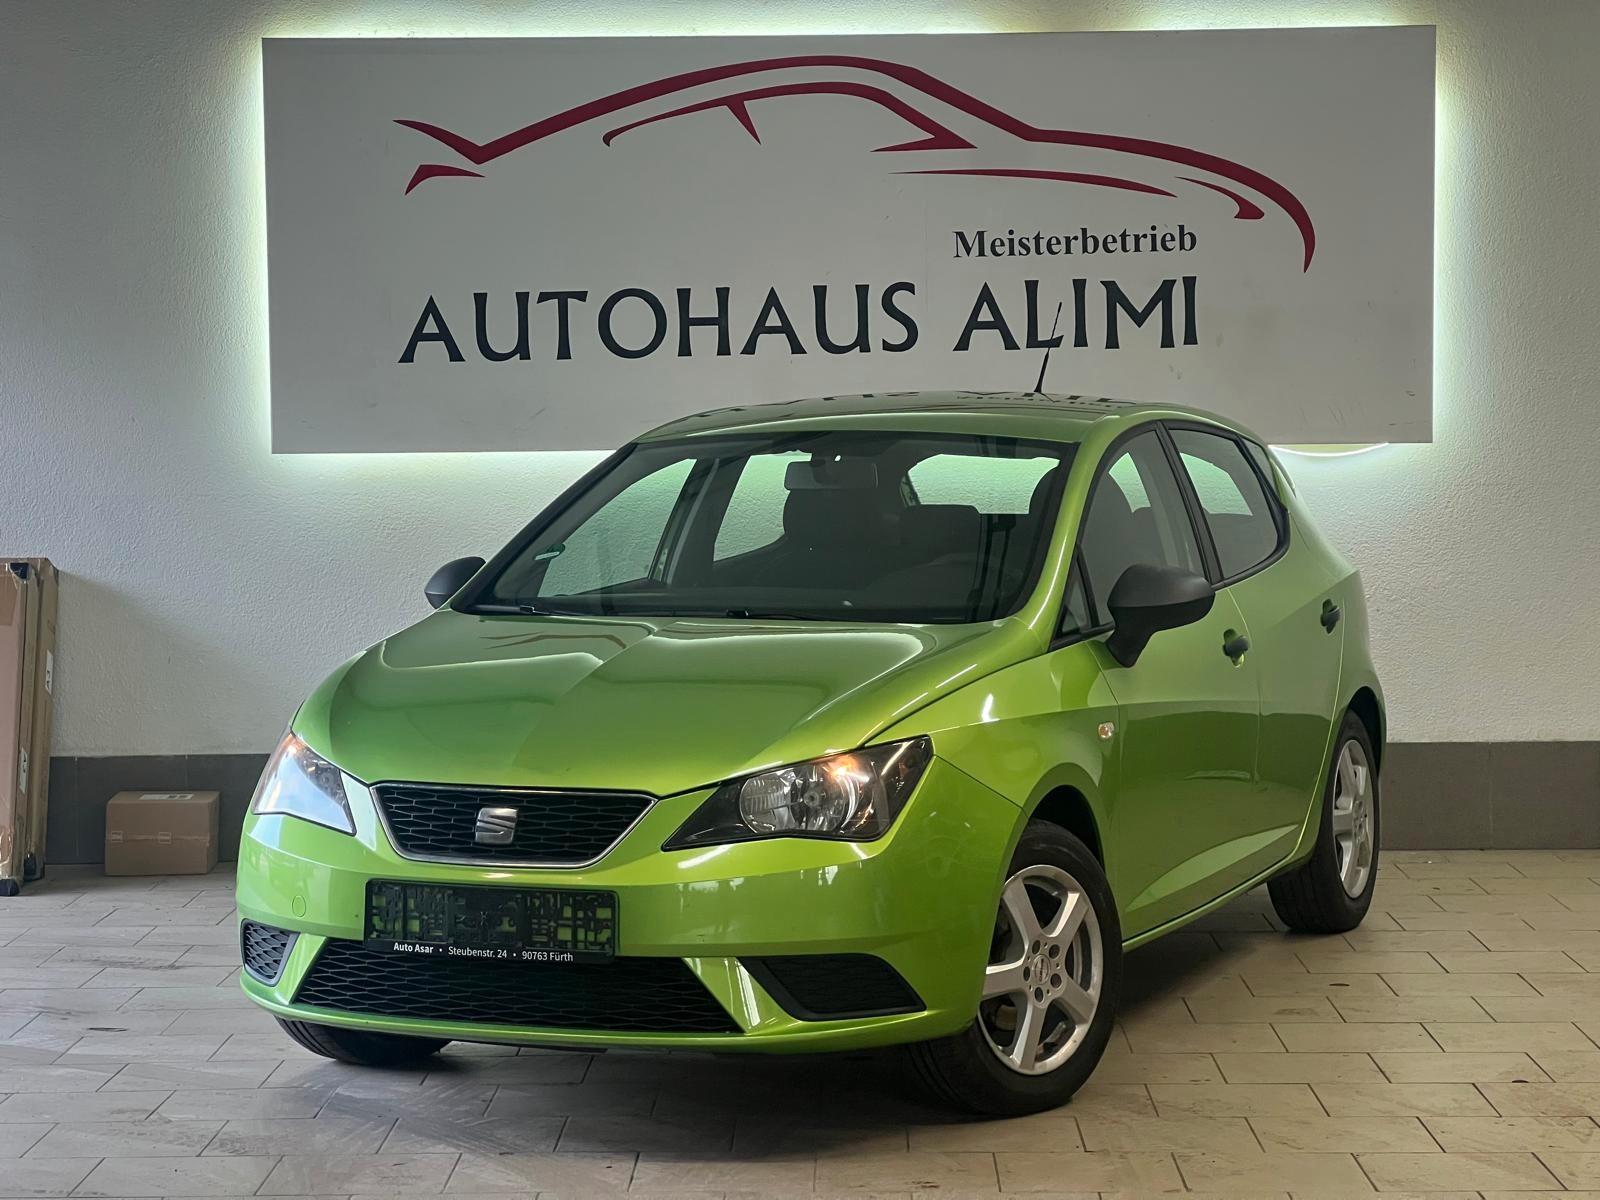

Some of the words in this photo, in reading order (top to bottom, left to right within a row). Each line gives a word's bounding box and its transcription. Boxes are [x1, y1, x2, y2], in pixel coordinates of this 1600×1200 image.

[953, 224, 1197, 259] Meisterbetrieb
[397, 281, 919, 364] AUTOHAUS
[952, 275, 1199, 352] ALIMI
[393, 942, 413, 952] Auto
[414, 943, 434, 954] Asar
[448, 946, 496, 958] Steubenstr.
[497, 949, 507, 958] 24
[521, 950, 548, 961] 90763
[549, 952, 574, 962] Fürth
